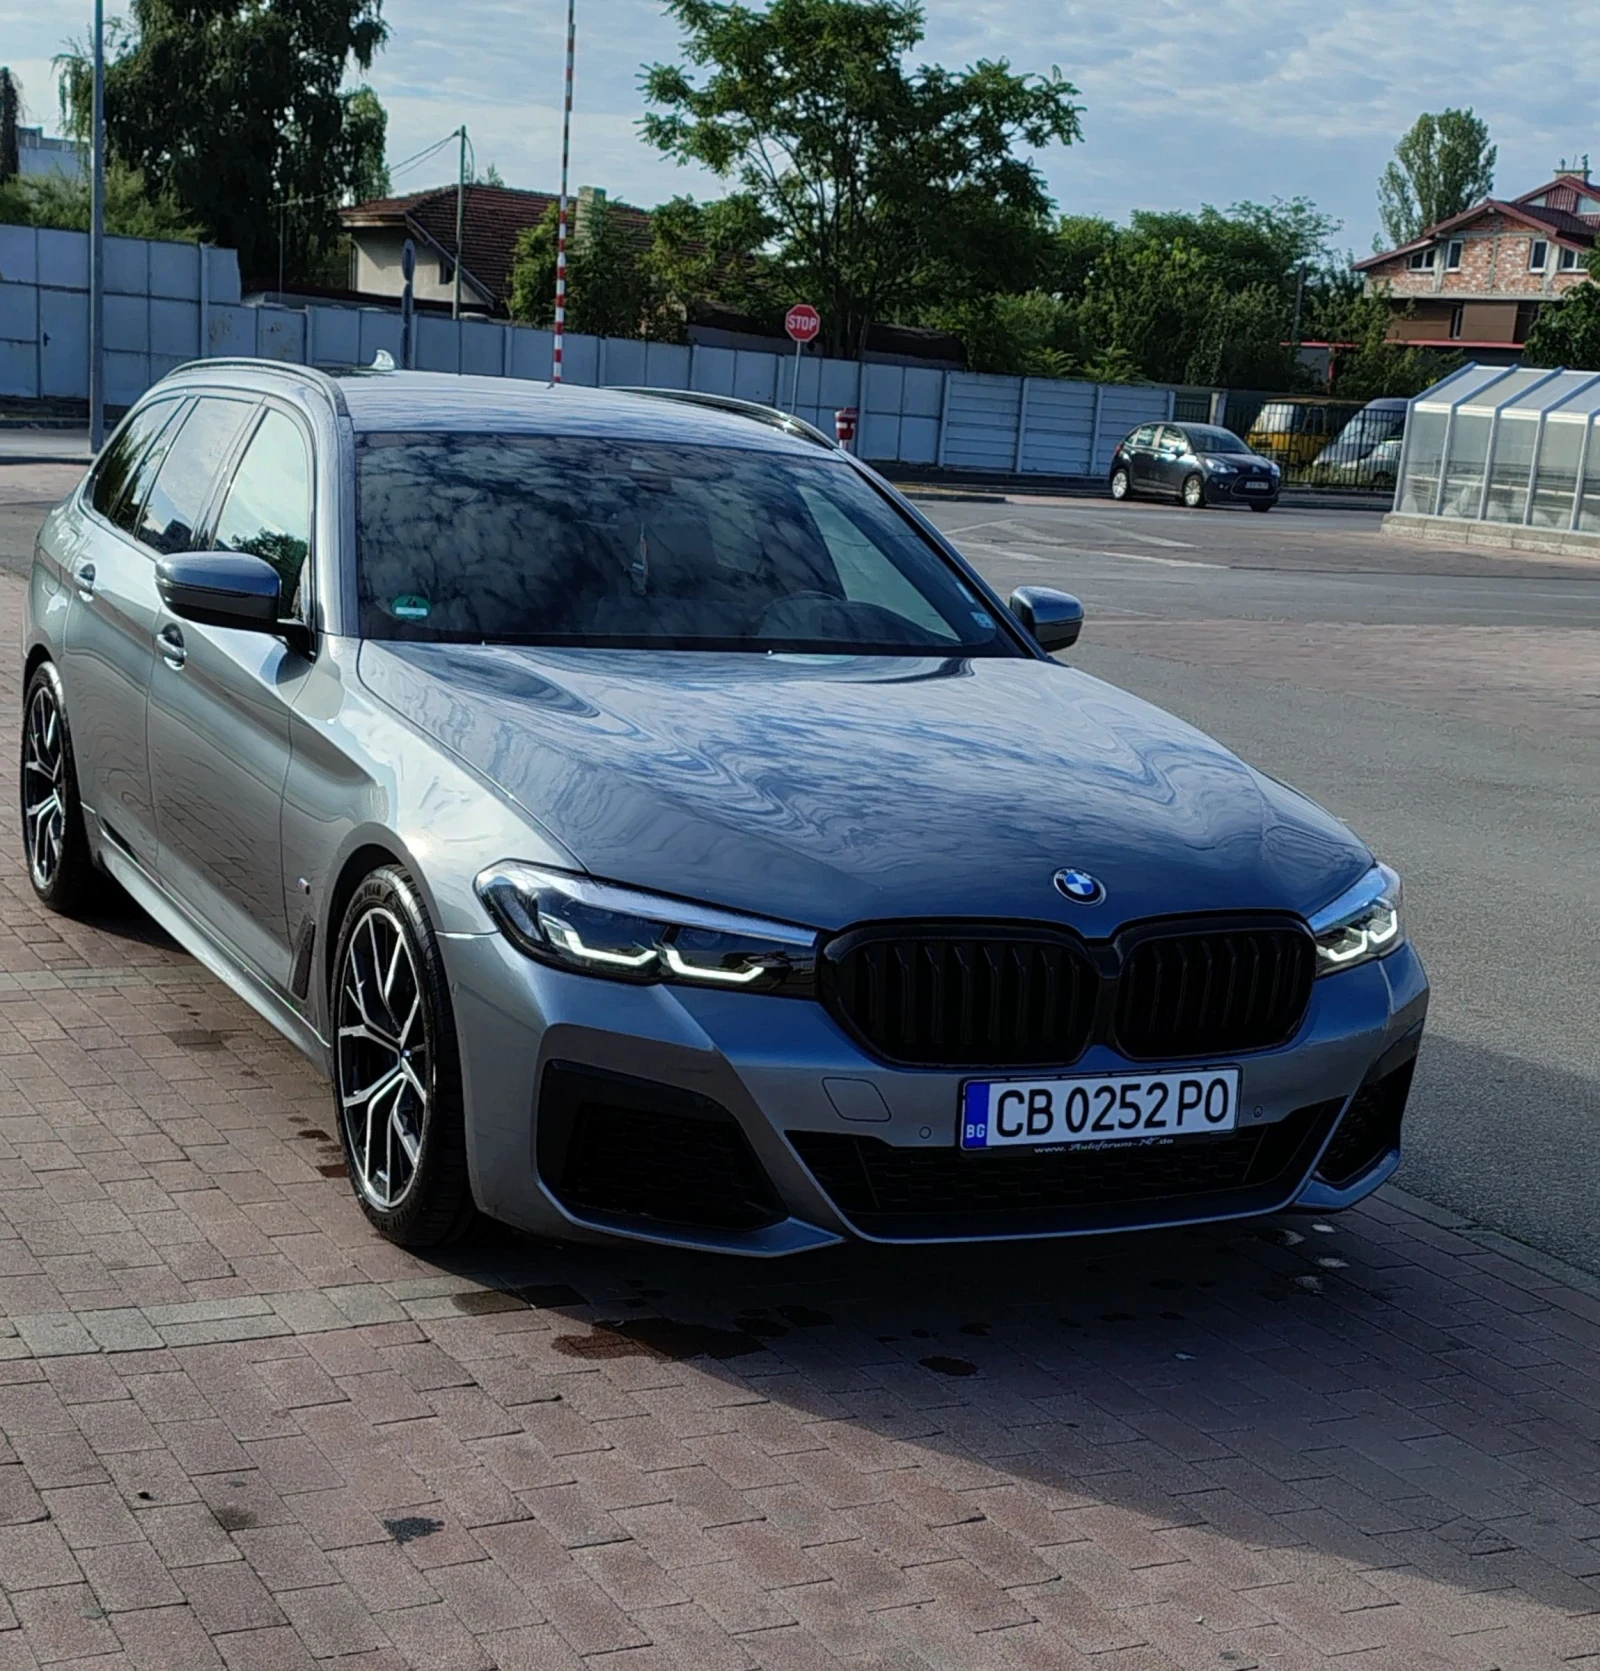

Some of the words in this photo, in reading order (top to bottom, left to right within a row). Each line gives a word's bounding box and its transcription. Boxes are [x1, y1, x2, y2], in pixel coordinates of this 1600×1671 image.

[788, 315, 817, 331] STOP
[996, 1089, 1054, 1138] CB
[1065, 1082, 1169, 1133] 0252
[966, 1124, 986, 1138] BG
